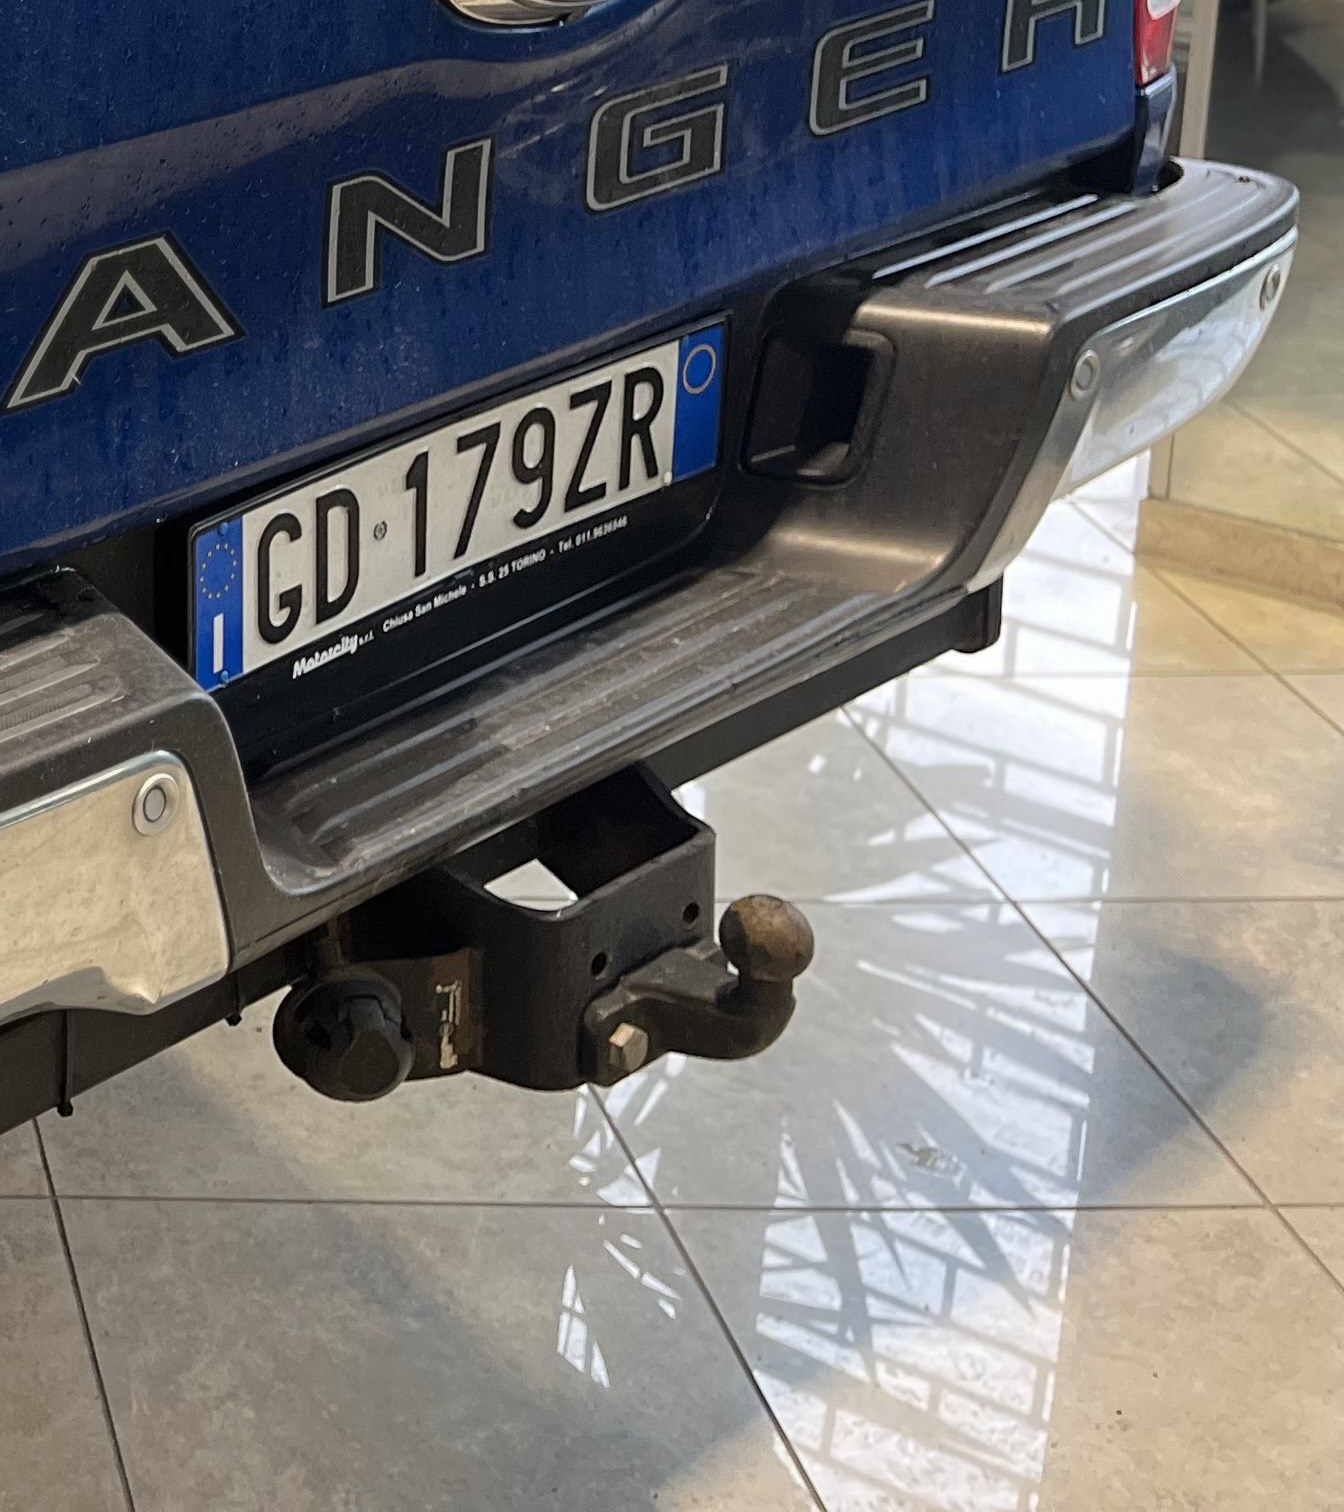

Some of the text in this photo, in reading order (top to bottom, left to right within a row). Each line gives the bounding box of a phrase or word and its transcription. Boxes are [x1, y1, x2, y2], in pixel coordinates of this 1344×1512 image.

[257, 366, 664, 645] GD 179ZR
[292, 633, 358, 679] Motorcity
[414, 601, 432, 617] San
[511, 548, 547, 572] TORINO
